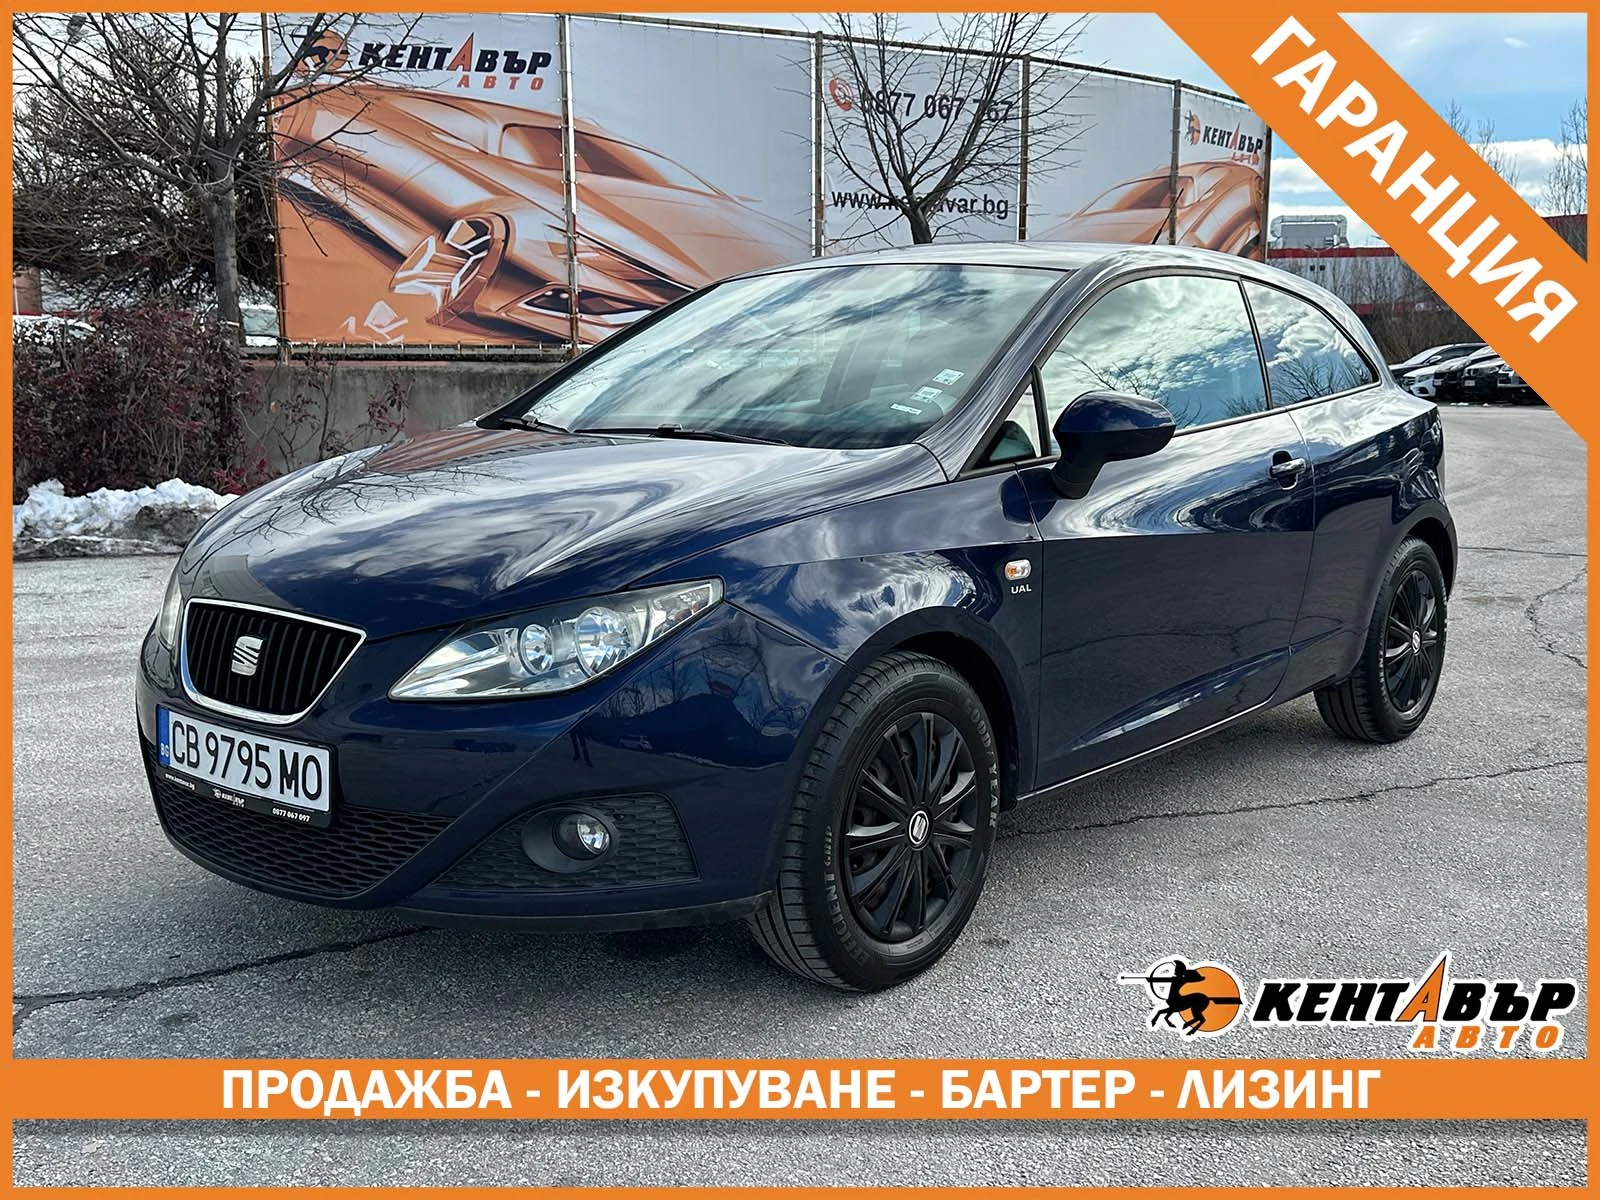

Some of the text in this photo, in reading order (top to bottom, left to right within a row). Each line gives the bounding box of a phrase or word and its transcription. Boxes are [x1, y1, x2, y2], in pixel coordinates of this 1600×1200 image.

[358, 32, 552, 74] КЕНТАВЪР
[457, 75, 544, 91] АВТО
[924, 94, 964, 120] 067
[1202, 121, 1263, 154] КЕНТАВЪР
[832, 191, 1009, 219] www.kevar.bg
[1011, 584, 1032, 594] UAL
[160, 743, 170, 758] BG
[172, 720, 322, 801] CB 9795 MO
